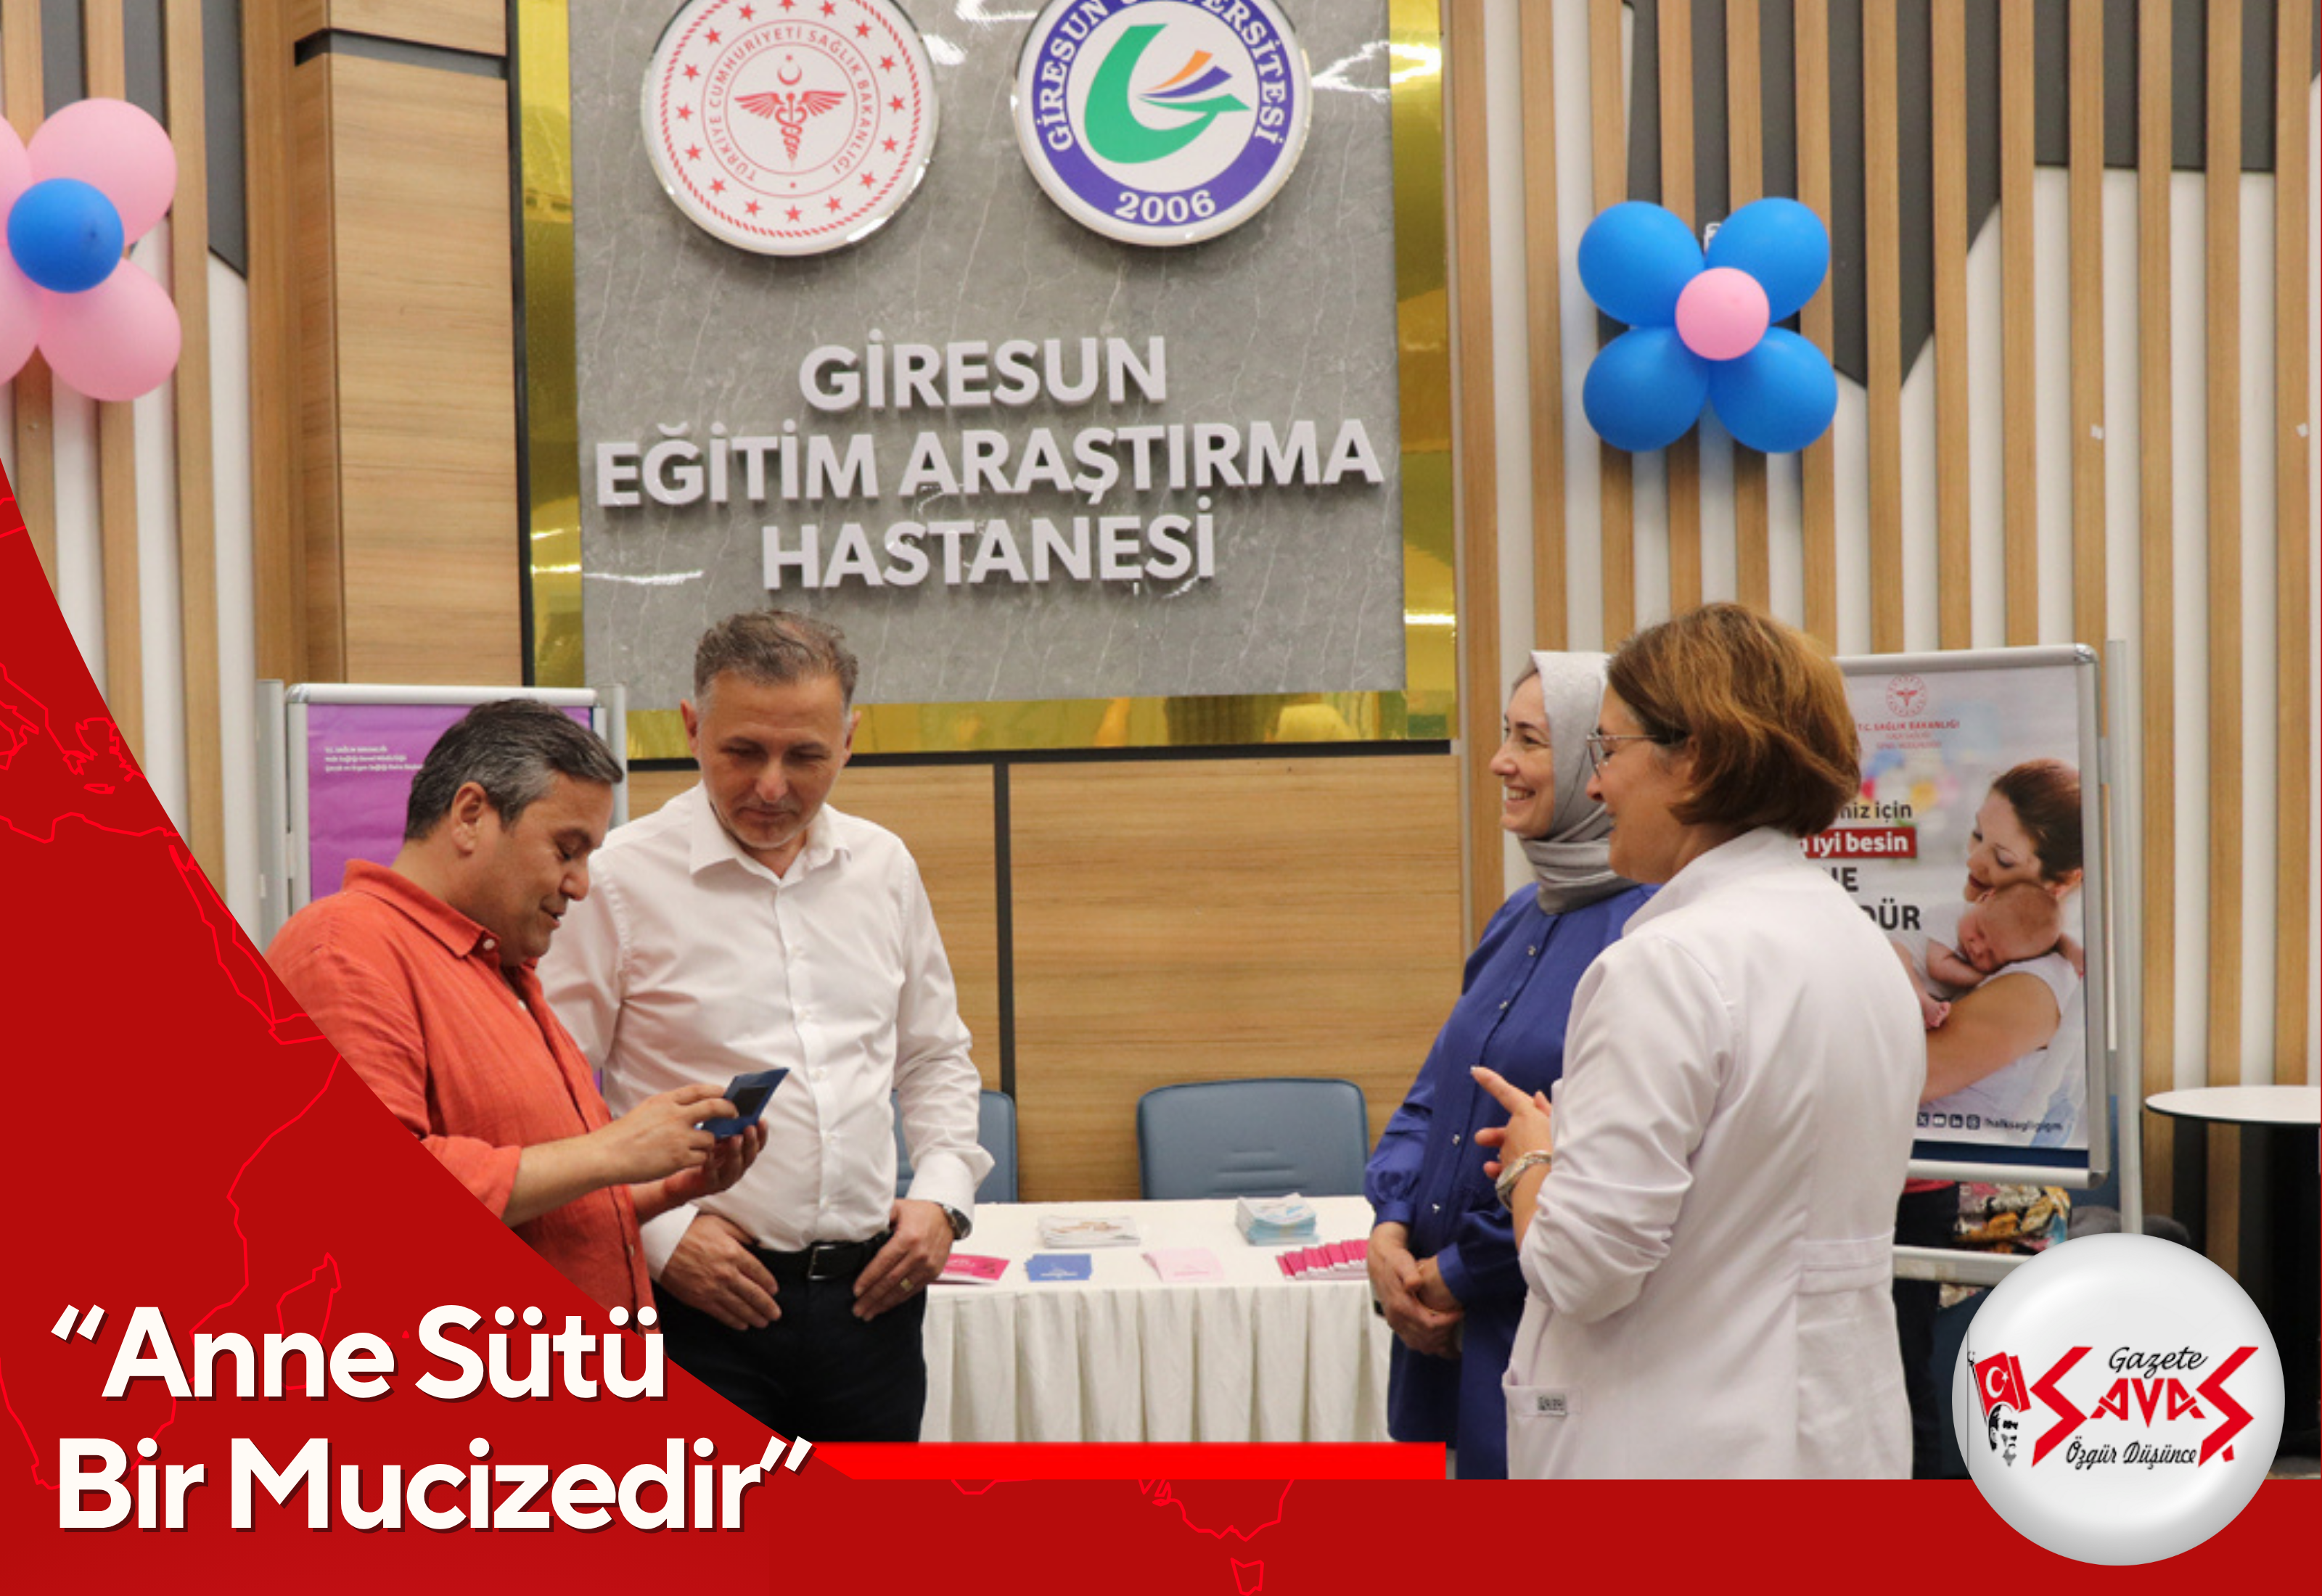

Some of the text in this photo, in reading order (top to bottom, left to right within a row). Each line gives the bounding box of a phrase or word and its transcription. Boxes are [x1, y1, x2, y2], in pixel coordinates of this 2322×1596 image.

[709, 24, 874, 182] TÜRKİYE CUMHURİYETİ SAĞLIK BAKANLIĞI
[1036, 0, 1111, 151] GİRESUN
[1115, 189, 1216, 223] 2006
[799, 328, 1167, 413] GİRESUN
[596, 418, 1384, 507] EĞİTİM ARAŞTIRMA
[762, 496, 1217, 589] HASTANESİ
[1845, 831, 1908, 852] besin
[1875, 799, 1913, 823] için
